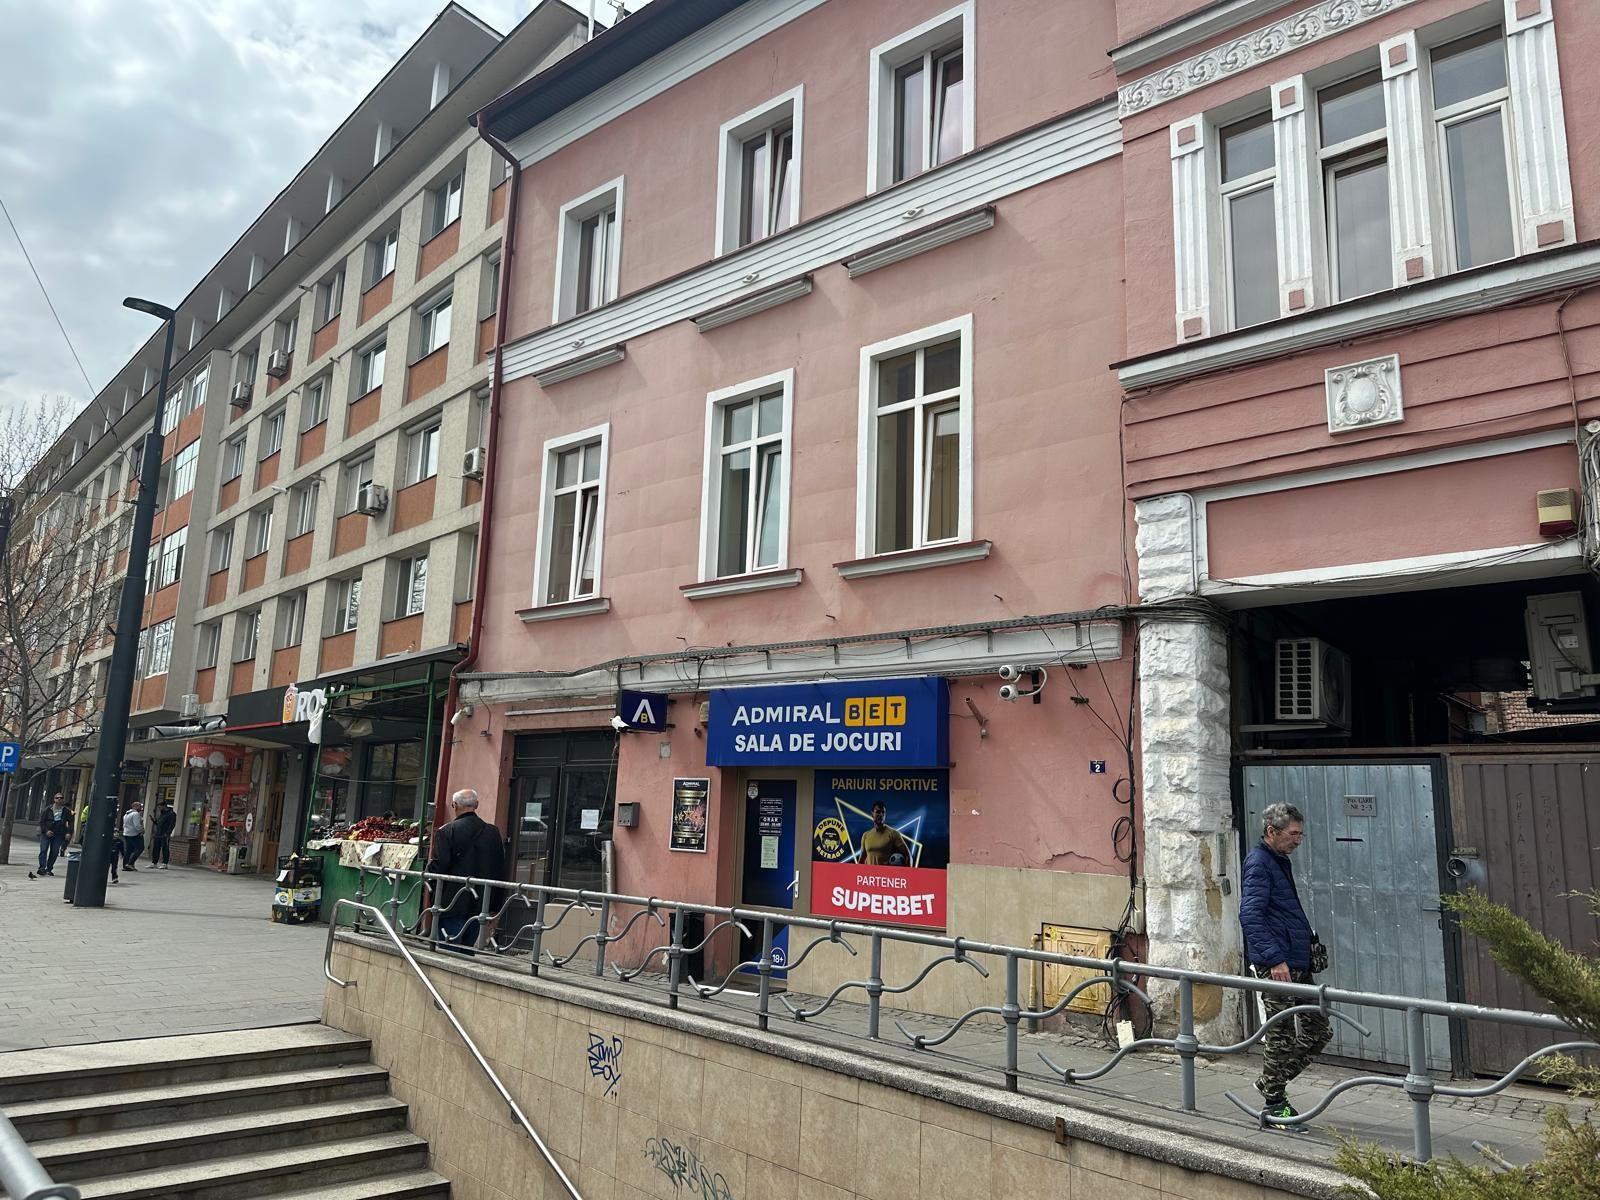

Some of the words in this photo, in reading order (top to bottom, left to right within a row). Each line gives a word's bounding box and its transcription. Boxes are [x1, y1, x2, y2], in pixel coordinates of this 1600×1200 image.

[732, 702, 841, 726] ADMIRAL
[848, 703, 902, 720] BET
[734, 733, 783, 752] SALA
[789, 733, 815, 751] DE
[821, 731, 902, 751] JOCURI
[1, 745, 14, 763] P
[1095, 764, 1101, 772] 2
[831, 777, 876, 791] PARIURI
[879, 778, 938, 791] SPORTIVE
[818, 819, 845, 832] DEPUNE
[816, 845, 845, 859] RETRAGE
[856, 875, 907, 889] PARTENER
[831, 886, 935, 916] SUPERBET
[772, 953, 784, 964] 18+
